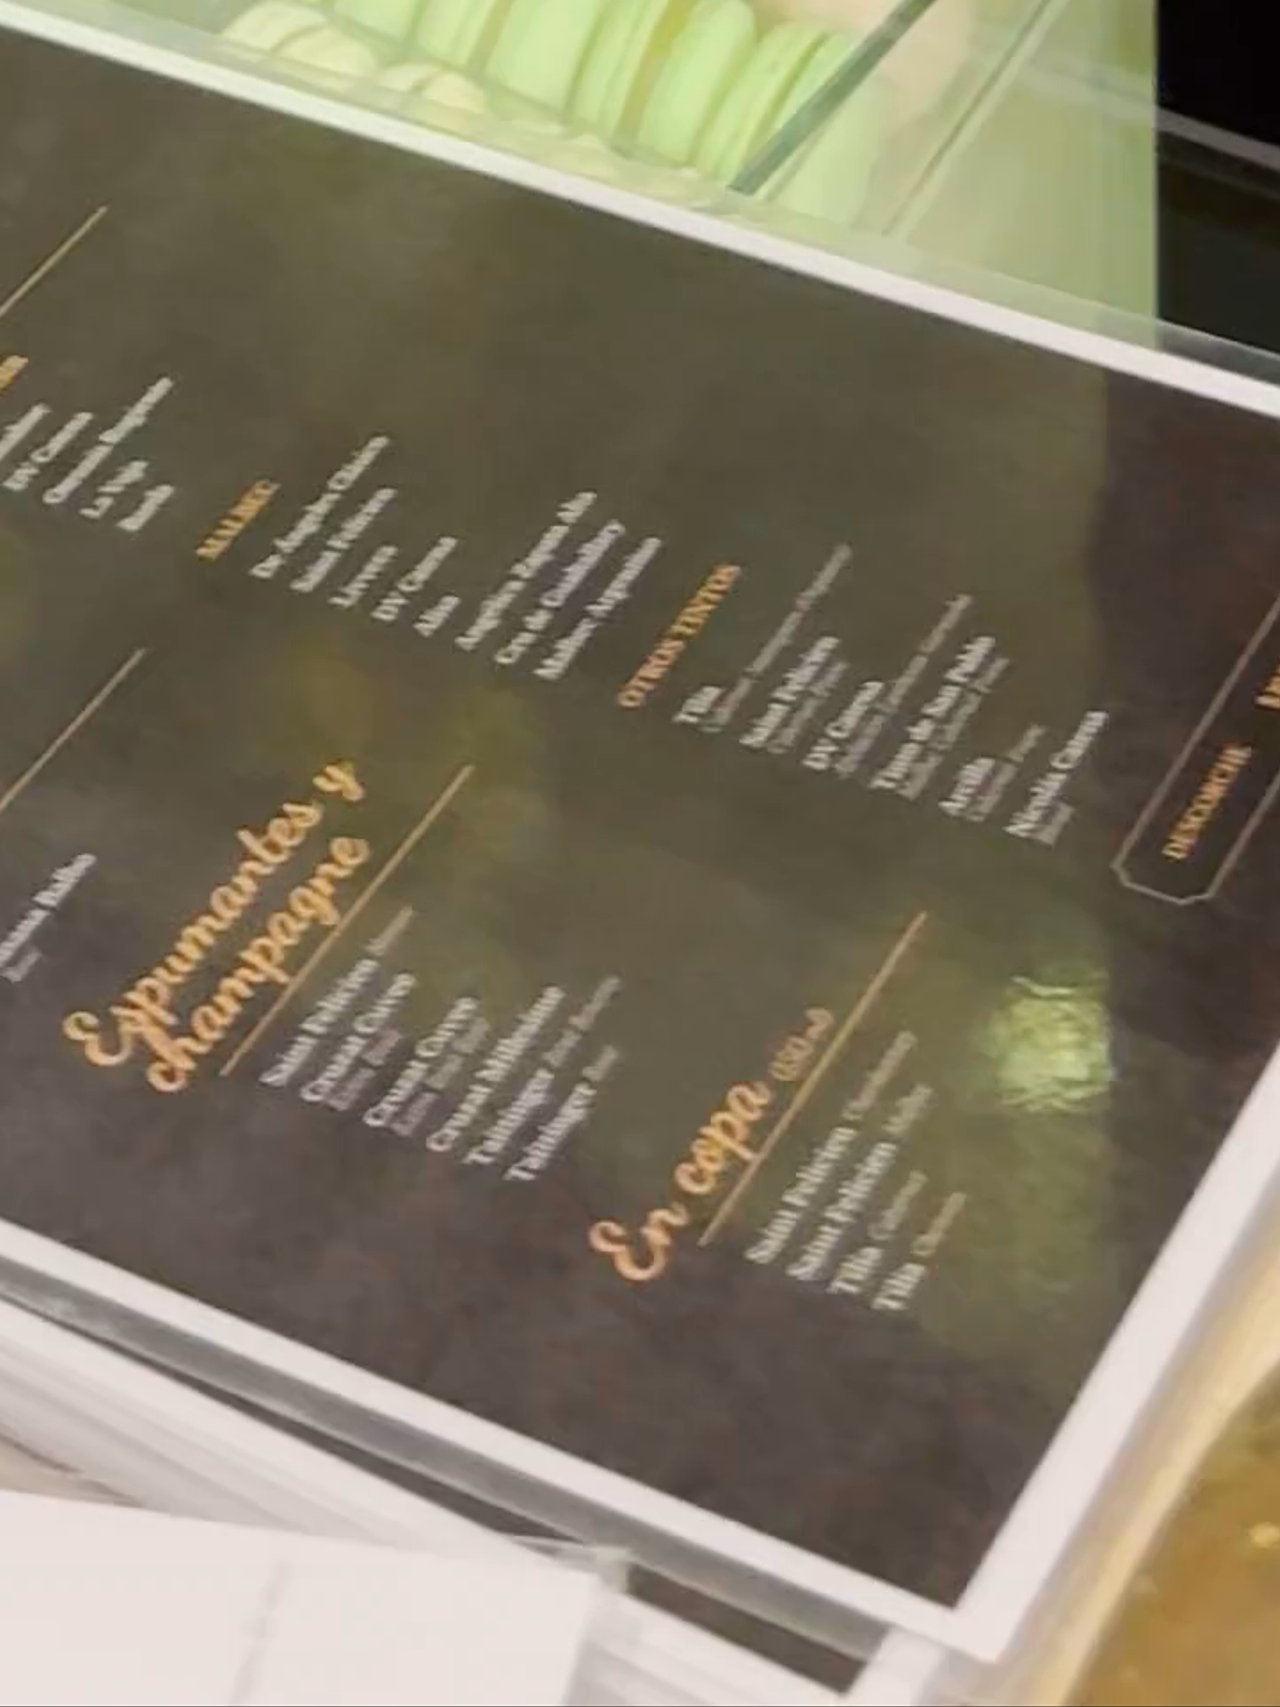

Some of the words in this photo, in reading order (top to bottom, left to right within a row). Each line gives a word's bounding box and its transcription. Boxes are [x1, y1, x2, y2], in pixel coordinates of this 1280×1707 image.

[63, 803, 321, 1066] Espumantes
[312, 763, 363, 801] y
[107, 817, 368, 1091] champagne
[588, 1205, 687, 1281] En
[674, 1082, 771, 1194] copa
